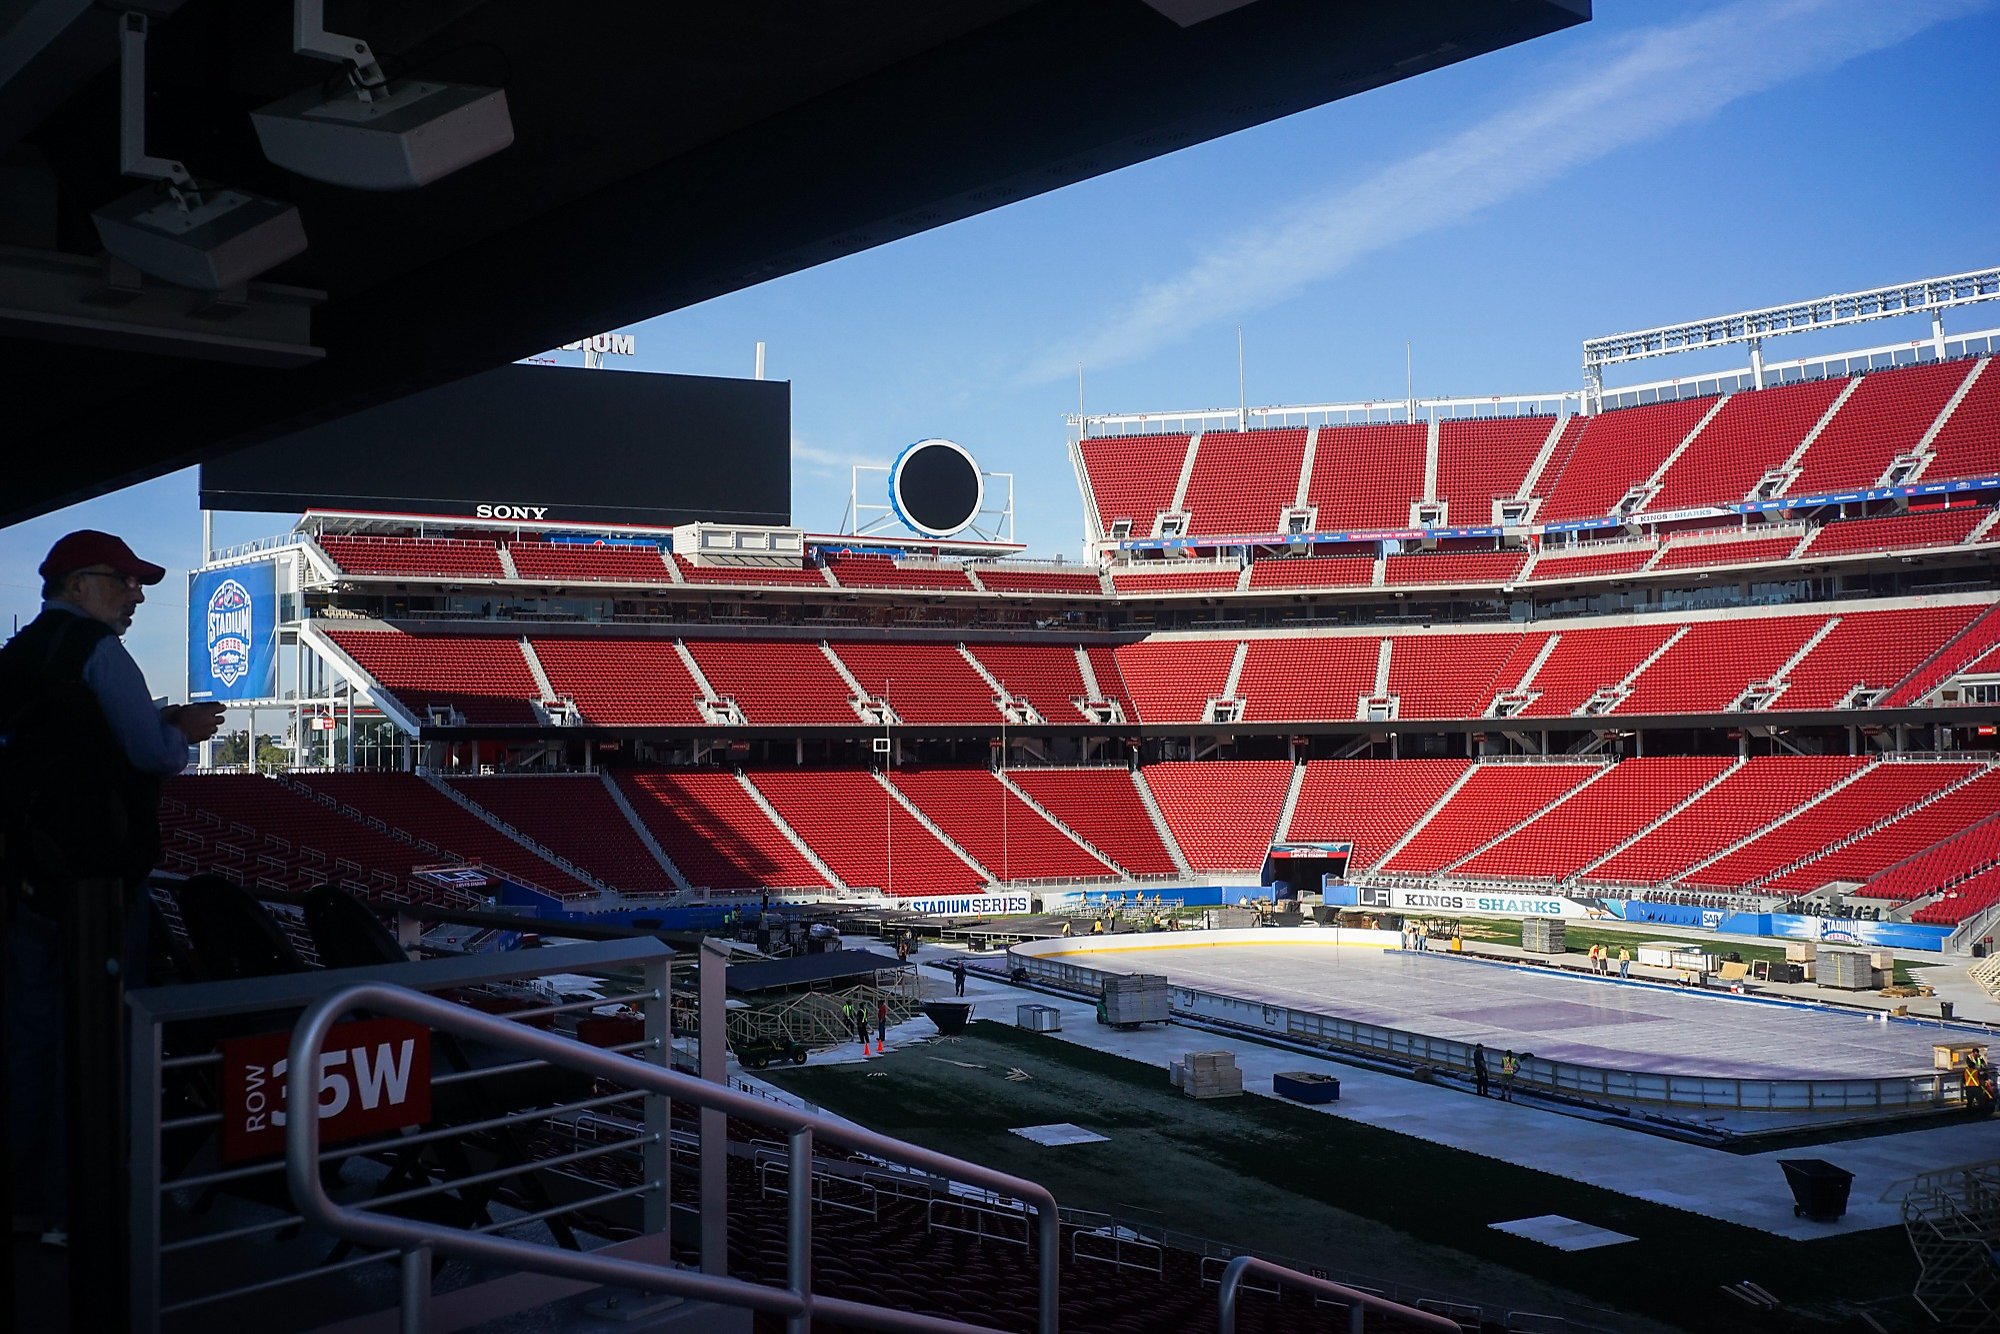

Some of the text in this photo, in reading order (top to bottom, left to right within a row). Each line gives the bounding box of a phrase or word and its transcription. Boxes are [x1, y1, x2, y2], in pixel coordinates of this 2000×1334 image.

[476, 504, 548, 520] SONY
[1640, 513, 1667, 522] KINGS
[1674, 508, 1712, 518] SHARKS
[209, 608, 250, 642] STADIUM
[217, 639, 242, 652] SERIES
[913, 897, 1027, 914] STADIUM SERIES
[1360, 888, 1391, 907] LA
[1404, 893, 1463, 909] KINGS
[1478, 898, 1561, 914] SHARKS
[1703, 913, 1719, 925] SAP
[1821, 917, 1858, 935] STADIUM
[245, 1064, 266, 1133] ROW
